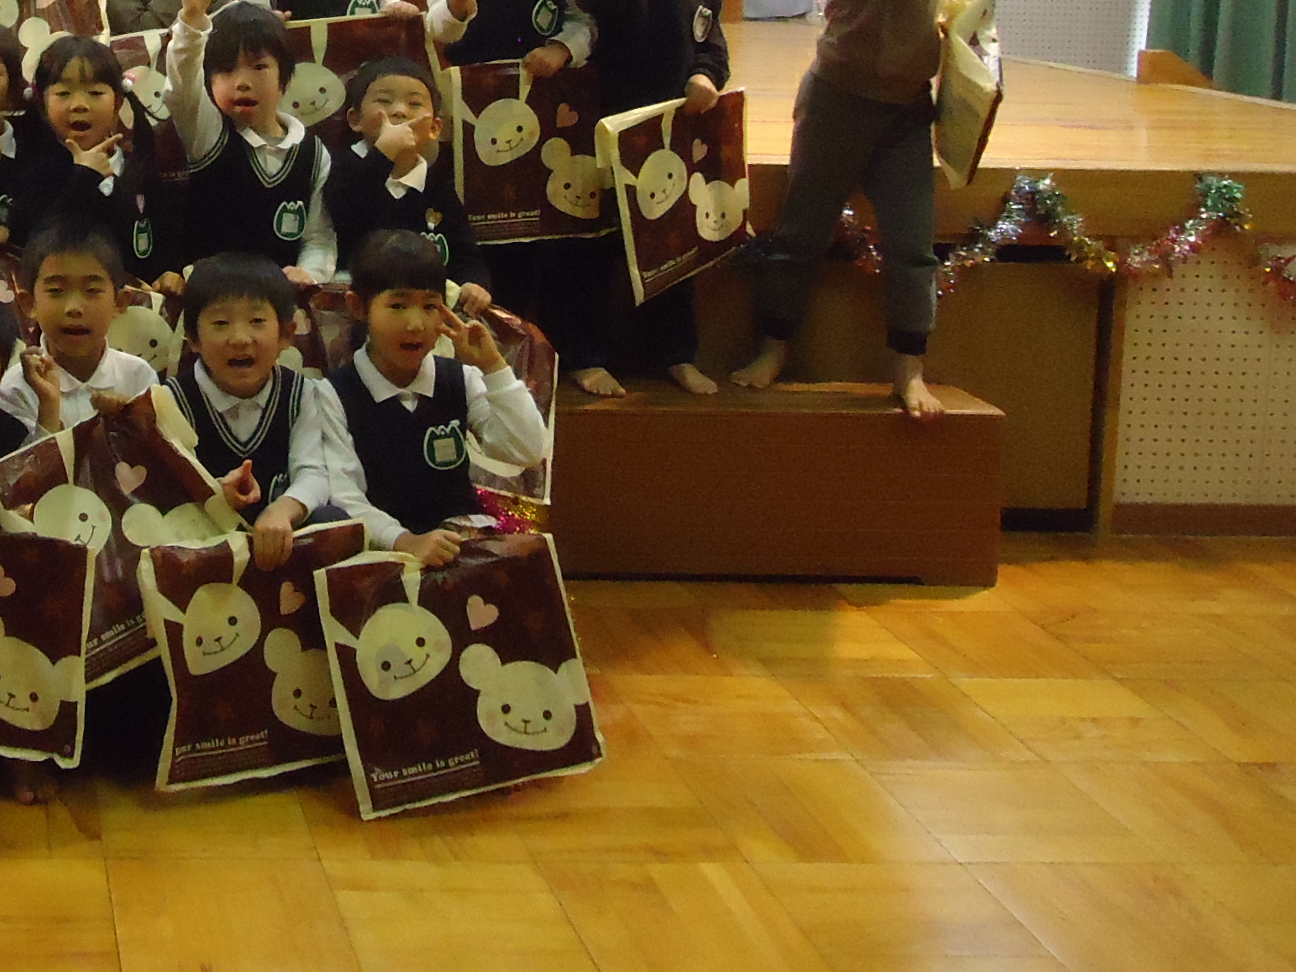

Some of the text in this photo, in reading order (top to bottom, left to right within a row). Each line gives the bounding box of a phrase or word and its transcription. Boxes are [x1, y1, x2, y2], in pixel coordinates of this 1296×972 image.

[86, 638, 98, 649] ur
[100, 623, 126, 641] smile
[195, 737, 225, 750] smile
[227, 736, 237, 746] is
[239, 728, 269, 746] great!
[371, 748, 479, 782] Your smile is great!
